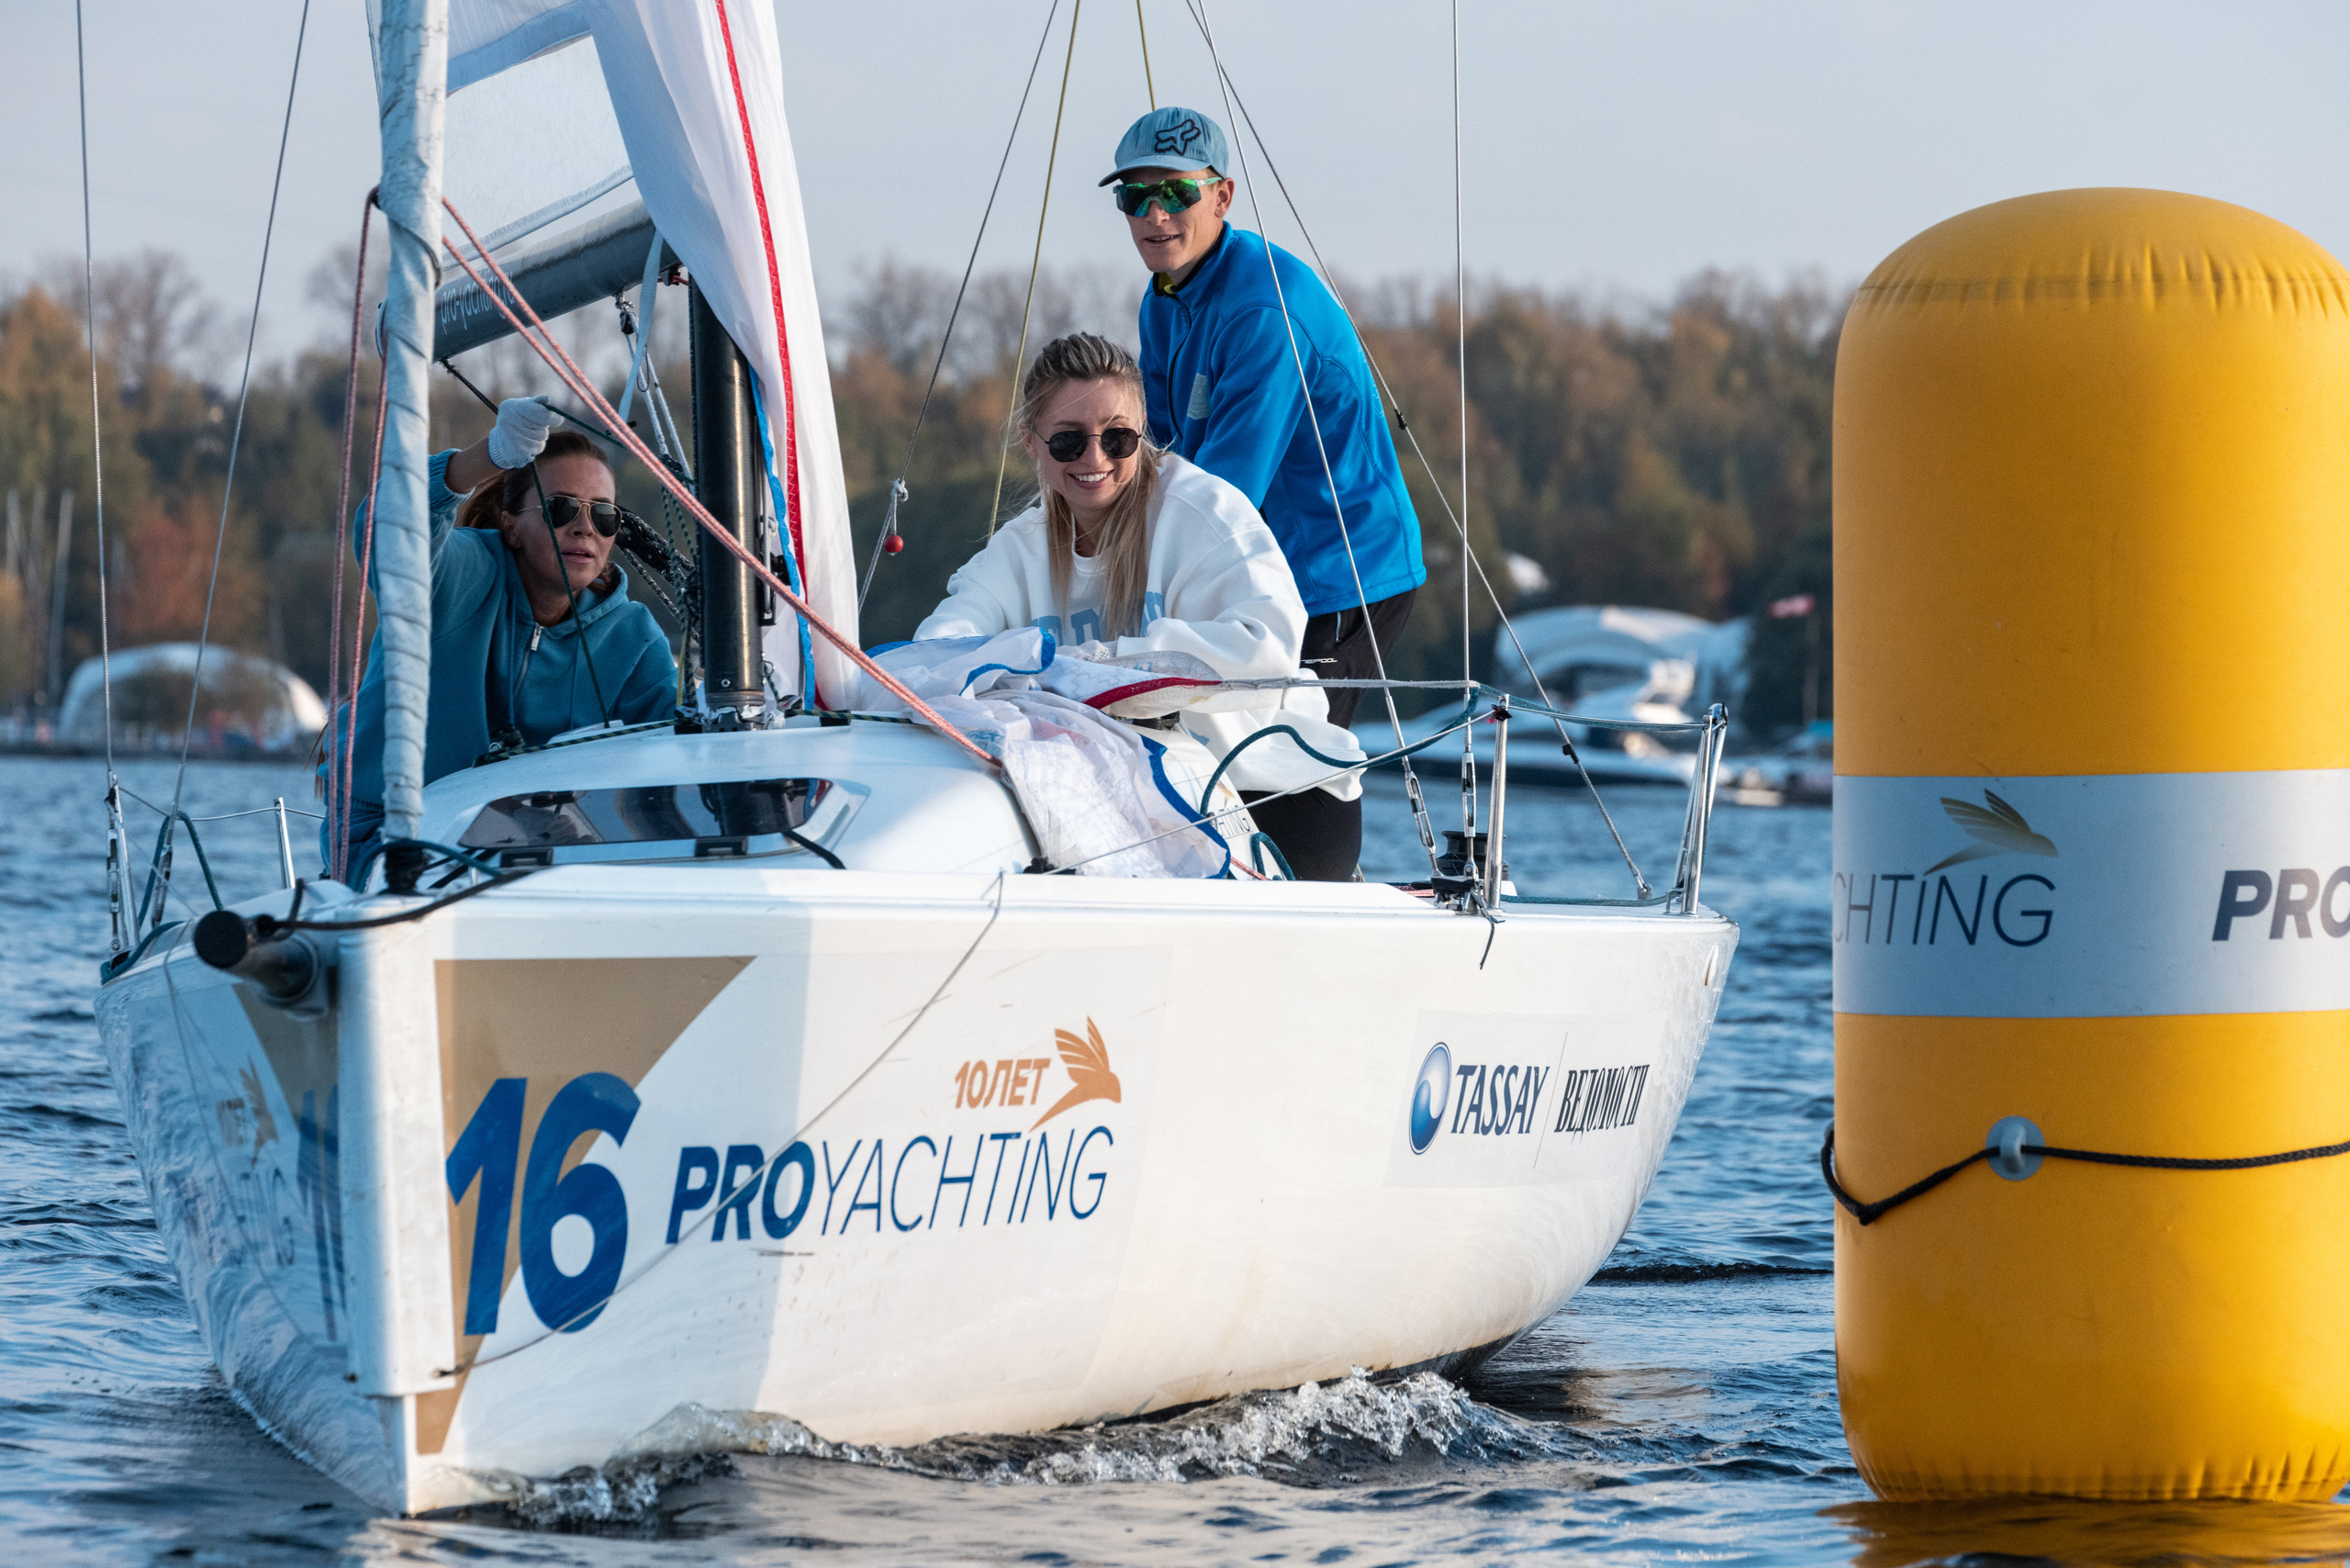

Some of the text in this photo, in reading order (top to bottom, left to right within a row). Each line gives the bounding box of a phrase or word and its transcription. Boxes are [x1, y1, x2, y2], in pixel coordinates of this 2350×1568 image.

[2211, 865, 2350, 942] PRO
[1449, 1064, 1550, 1137] TASSAY
[1553, 1063, 1651, 1146] ВЕДОМОСТИ
[445, 1070, 642, 1336] 16
[665, 1125, 1114, 1245] PROYACHTING
